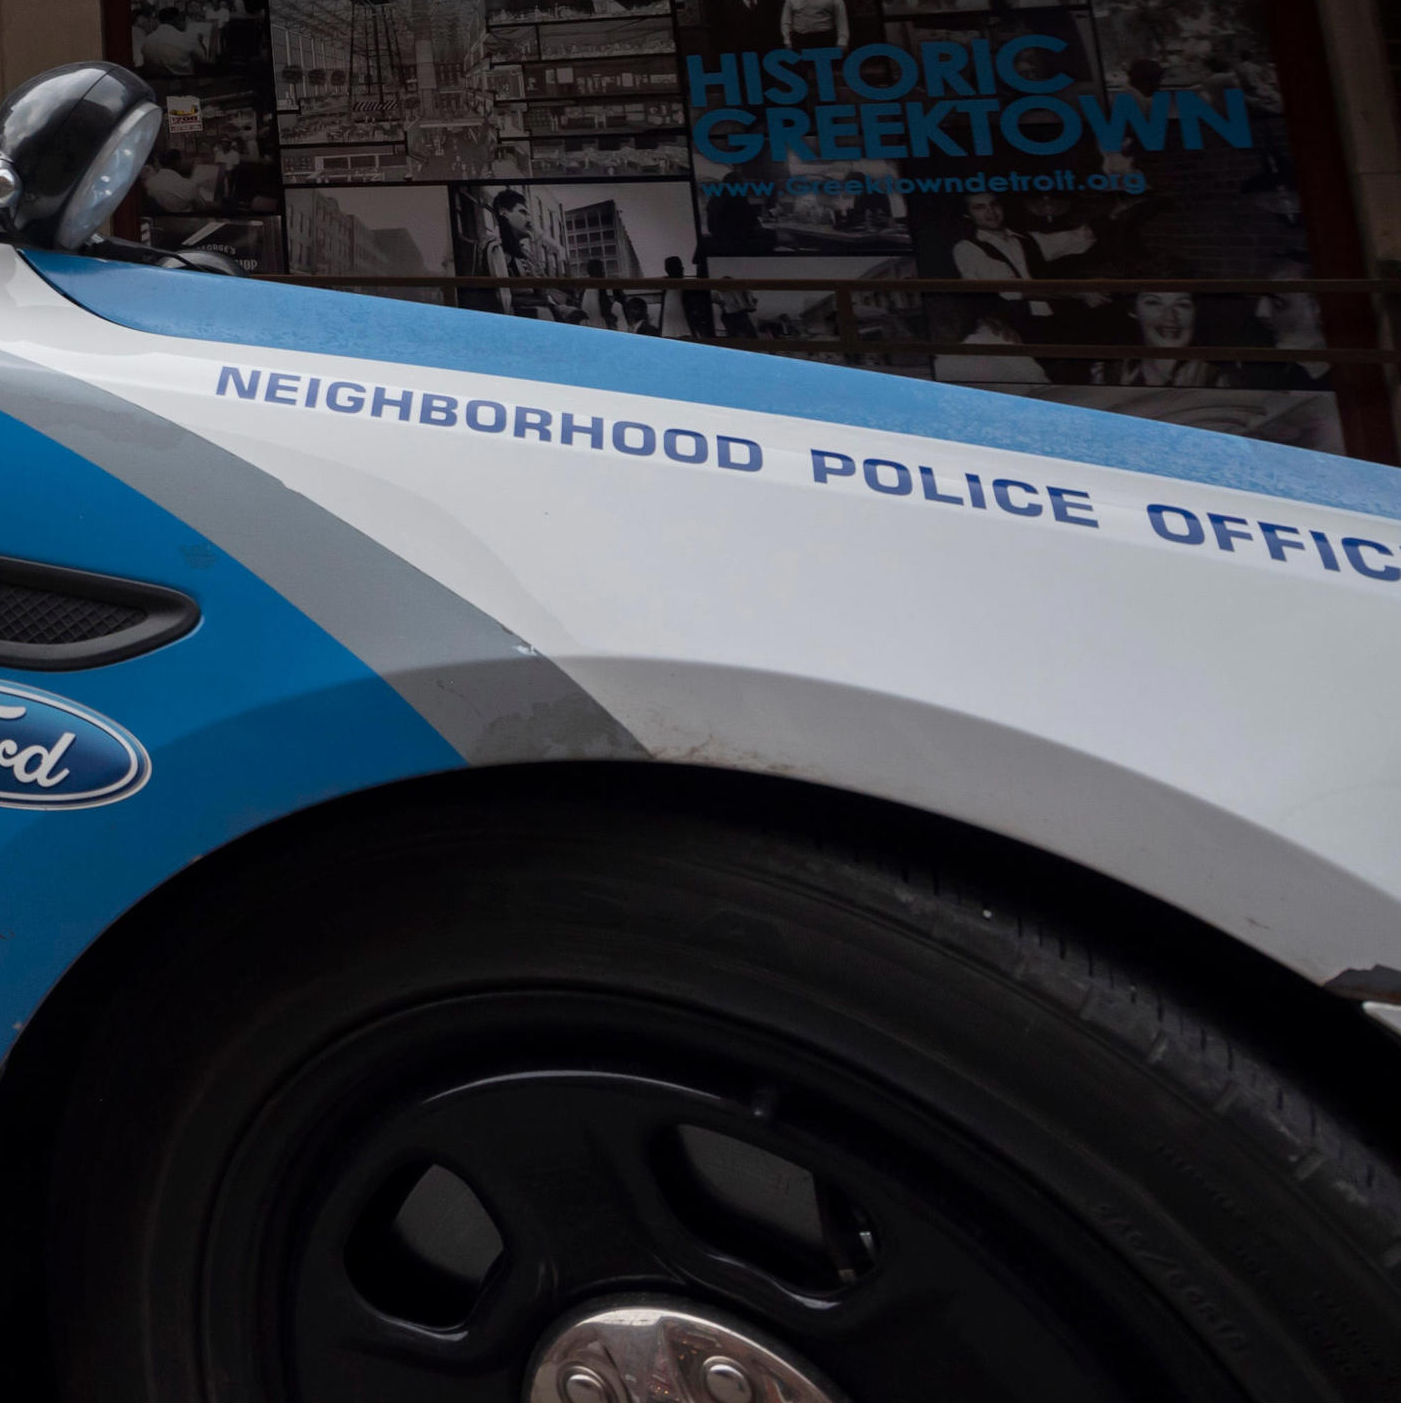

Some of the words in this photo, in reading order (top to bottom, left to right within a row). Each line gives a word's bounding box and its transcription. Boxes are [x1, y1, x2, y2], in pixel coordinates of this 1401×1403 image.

[686, 34, 1075, 108] HISTORIC
[692, 88, 1254, 164] GREEKTOWN
[214, 365, 764, 473] NEIGHBORHOOD
[809, 447, 1100, 529] POLICE
[1145, 502, 1401, 583] OFFIC
